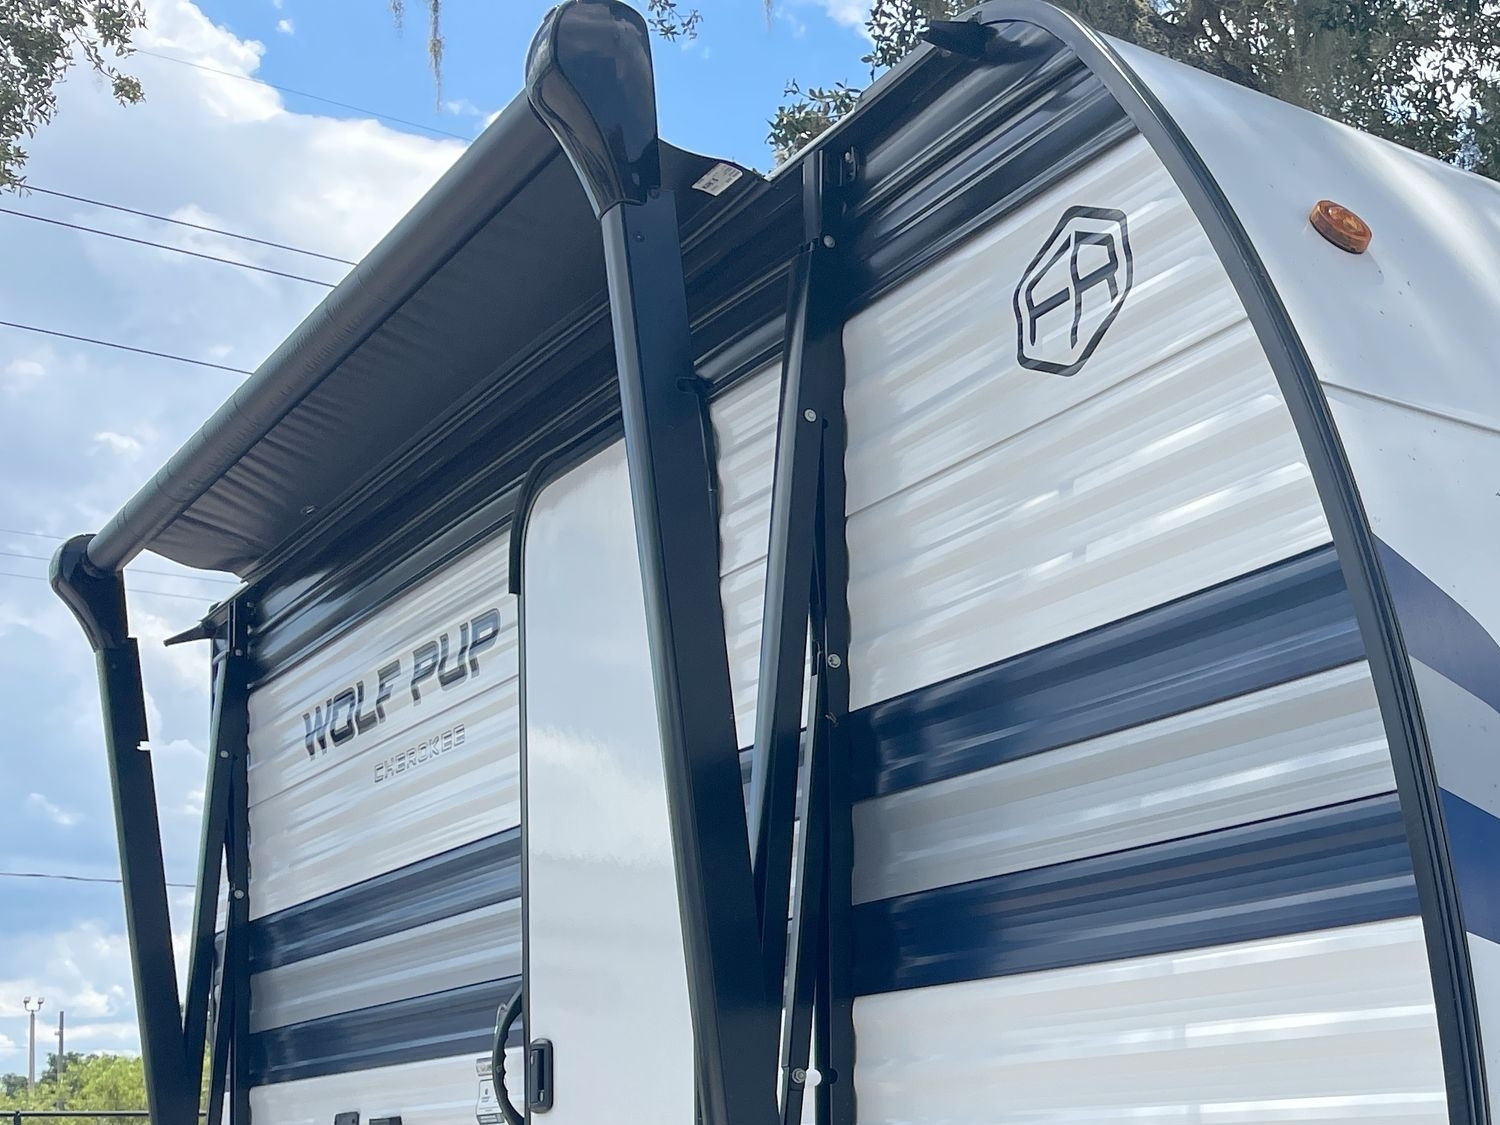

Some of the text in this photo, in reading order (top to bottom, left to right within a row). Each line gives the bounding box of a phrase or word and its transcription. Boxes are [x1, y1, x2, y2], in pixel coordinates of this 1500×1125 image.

[302, 607, 501, 761] WOLF PUP
[373, 723, 466, 784] CHEROKEE
